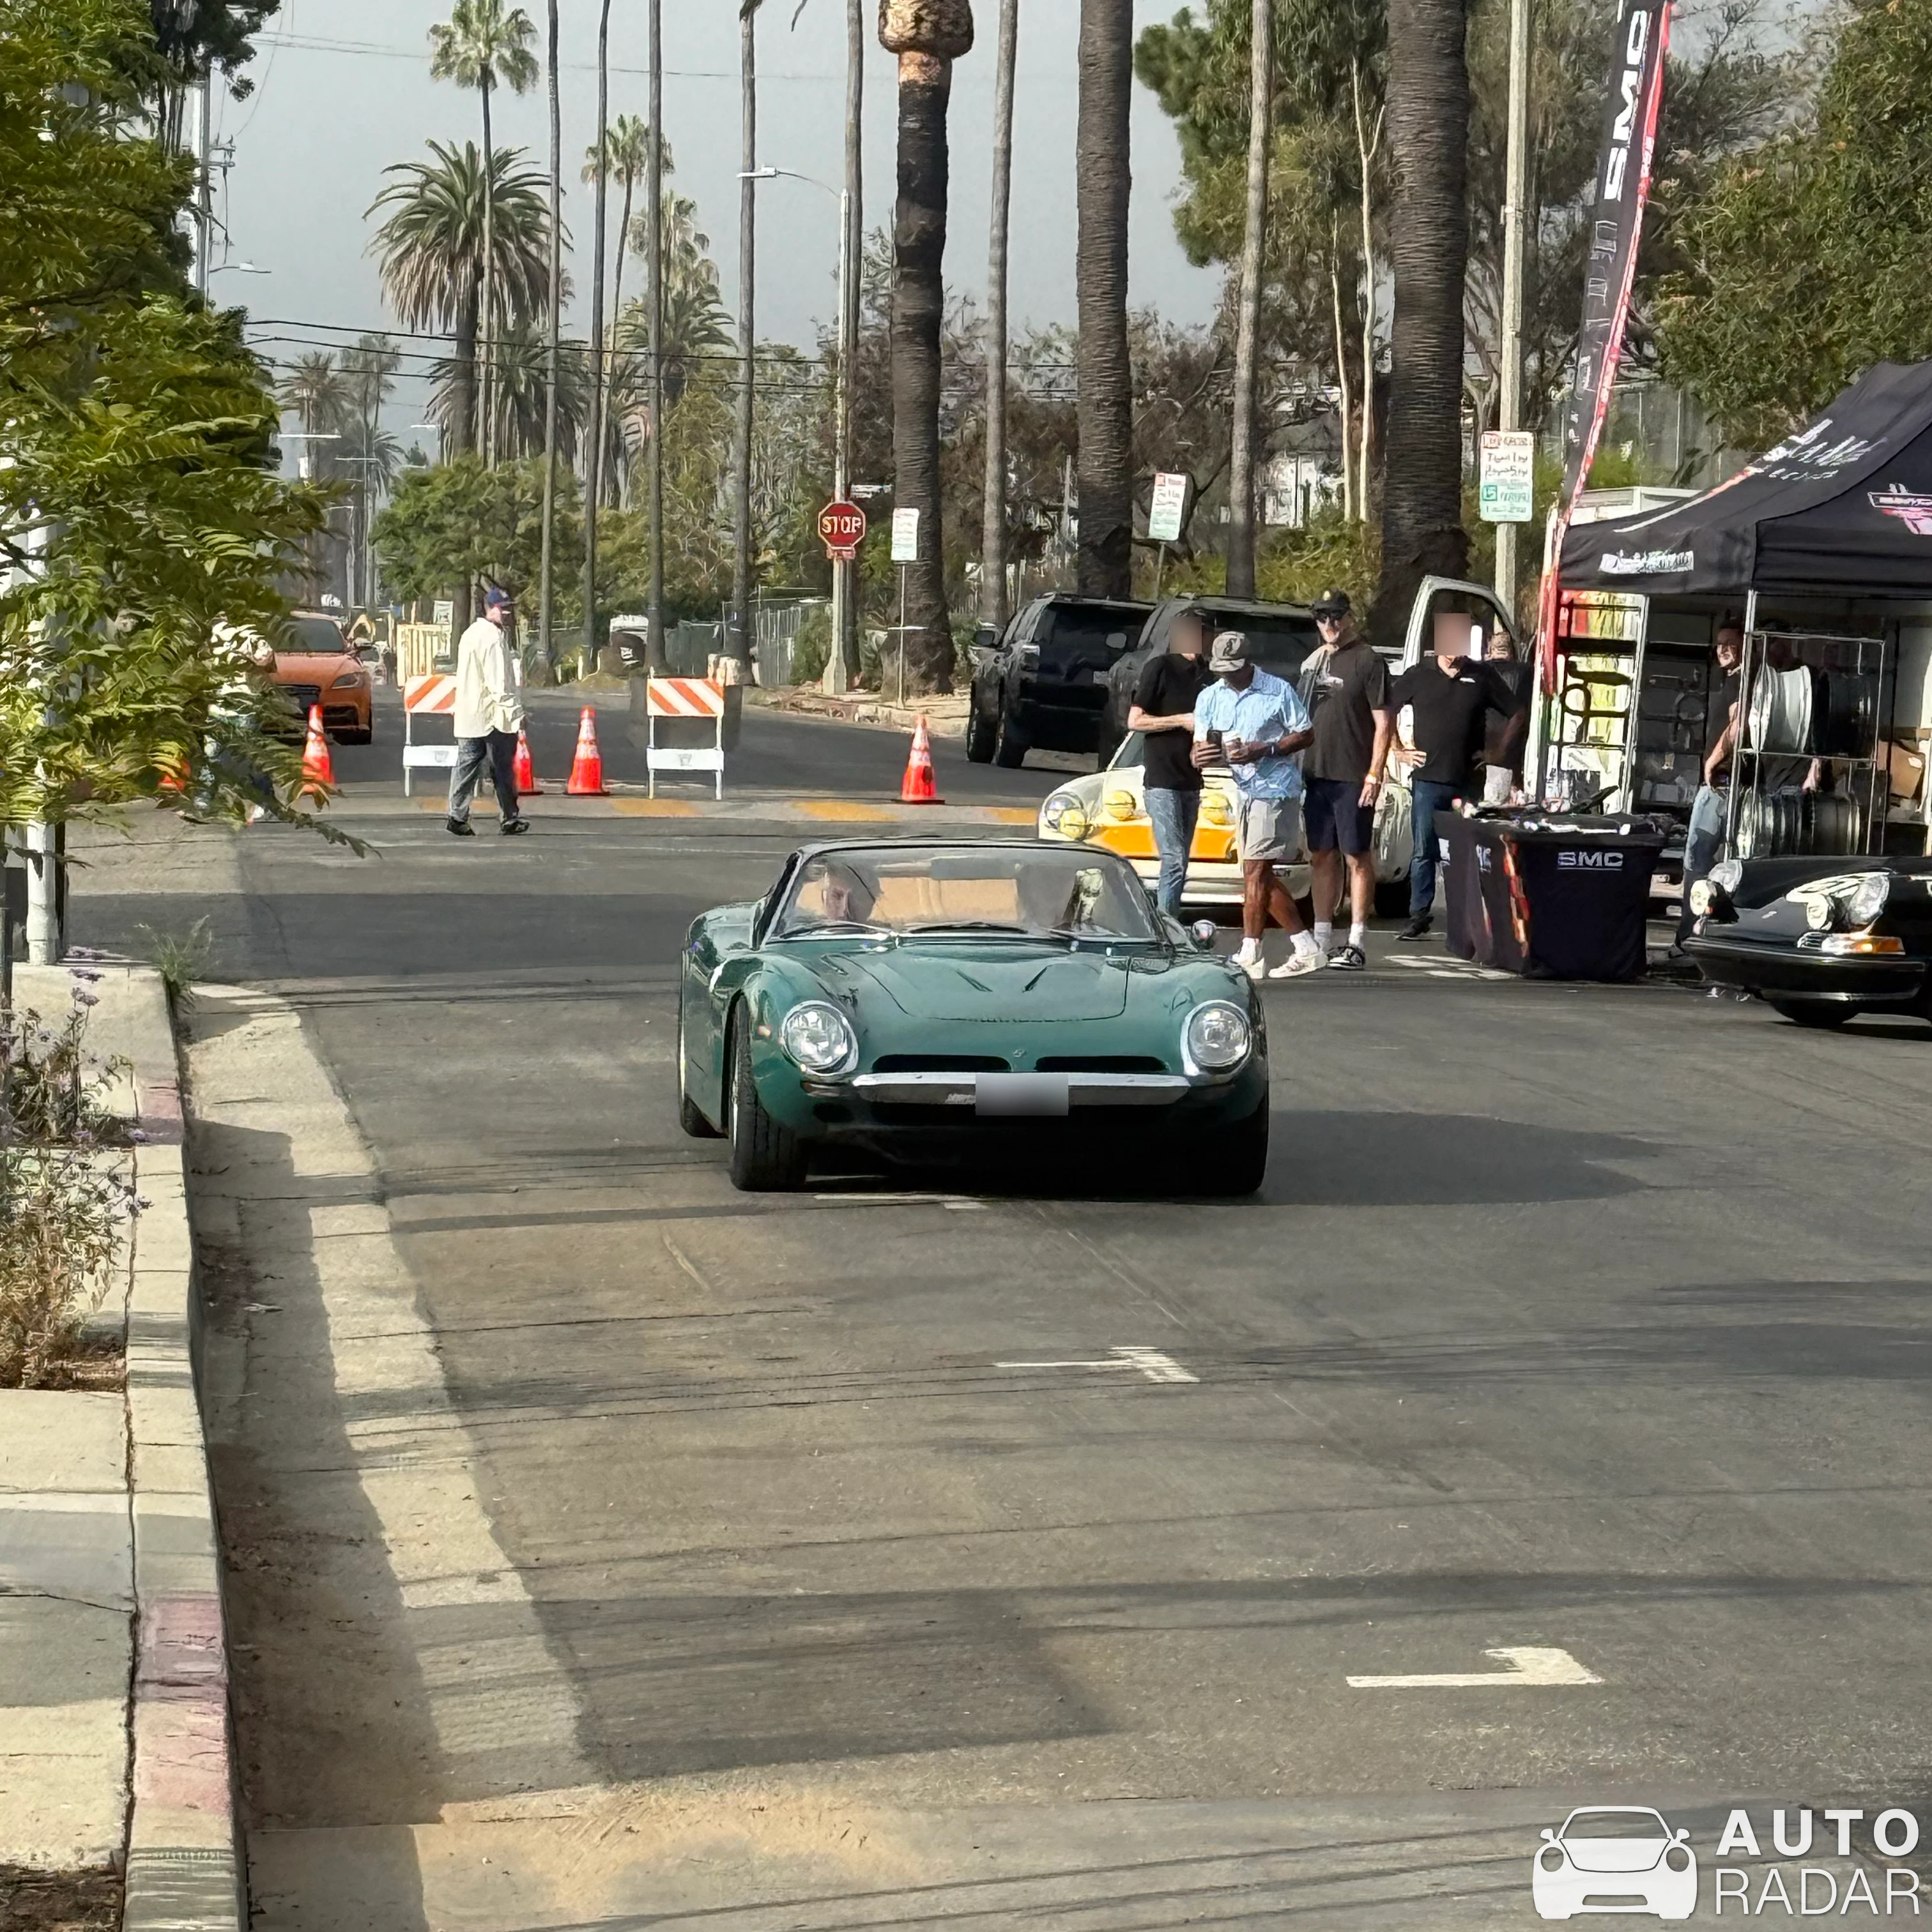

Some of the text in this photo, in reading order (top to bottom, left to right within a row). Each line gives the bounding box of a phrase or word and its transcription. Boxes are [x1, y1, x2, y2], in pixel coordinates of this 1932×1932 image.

[1604, 10, 1648, 201] SMC
[822, 516, 862, 534] STOP
[1558, 852, 1624, 867] SMC
